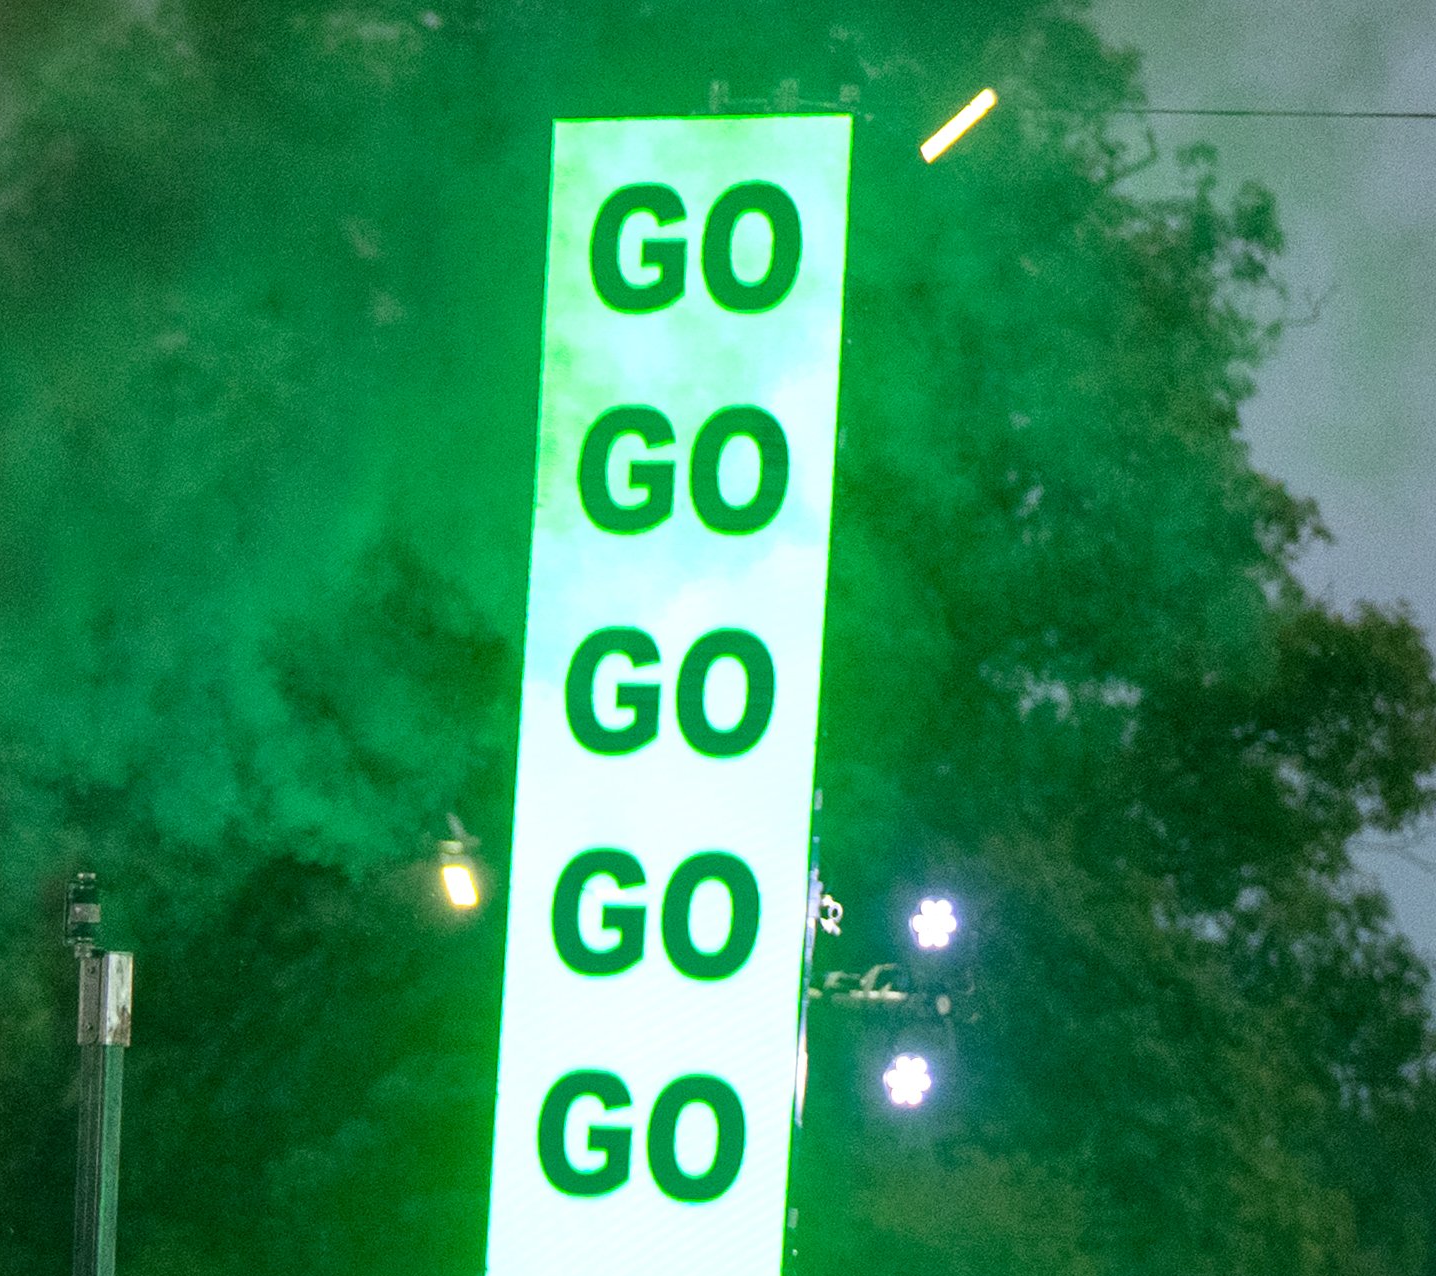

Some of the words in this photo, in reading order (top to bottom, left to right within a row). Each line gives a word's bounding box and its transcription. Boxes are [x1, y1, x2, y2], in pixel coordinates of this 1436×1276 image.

[589, 178, 803, 315] GO
[576, 403, 790, 537] GO
[563, 623, 777, 760] GO
[549, 847, 762, 983] GO
[536, 1069, 747, 1204] GO
